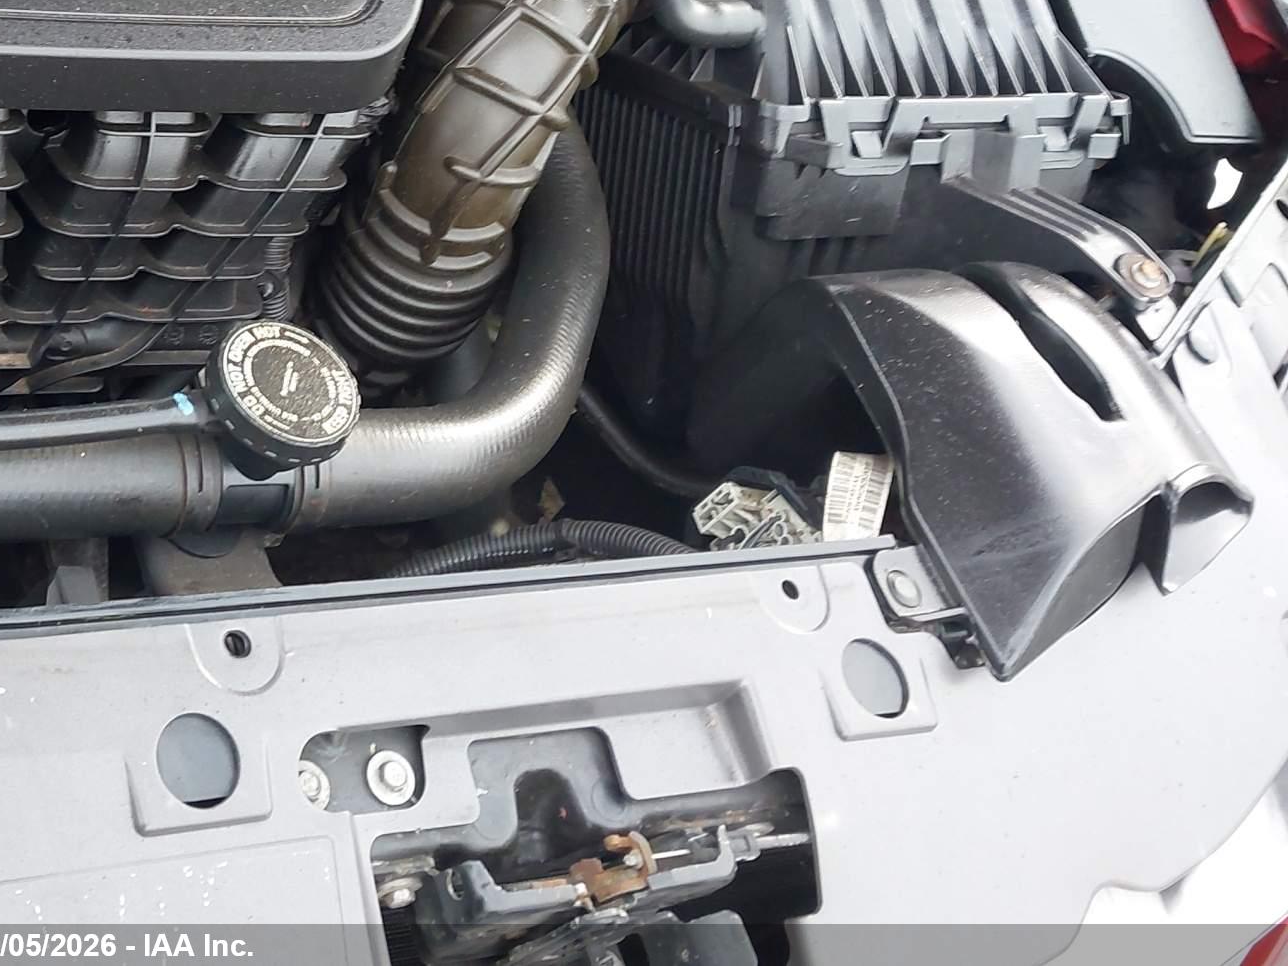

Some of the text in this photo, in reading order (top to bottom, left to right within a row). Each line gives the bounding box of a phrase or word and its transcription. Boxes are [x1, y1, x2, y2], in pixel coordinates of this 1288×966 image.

[228, 326, 281, 417] DO NOT OPEN HOT
